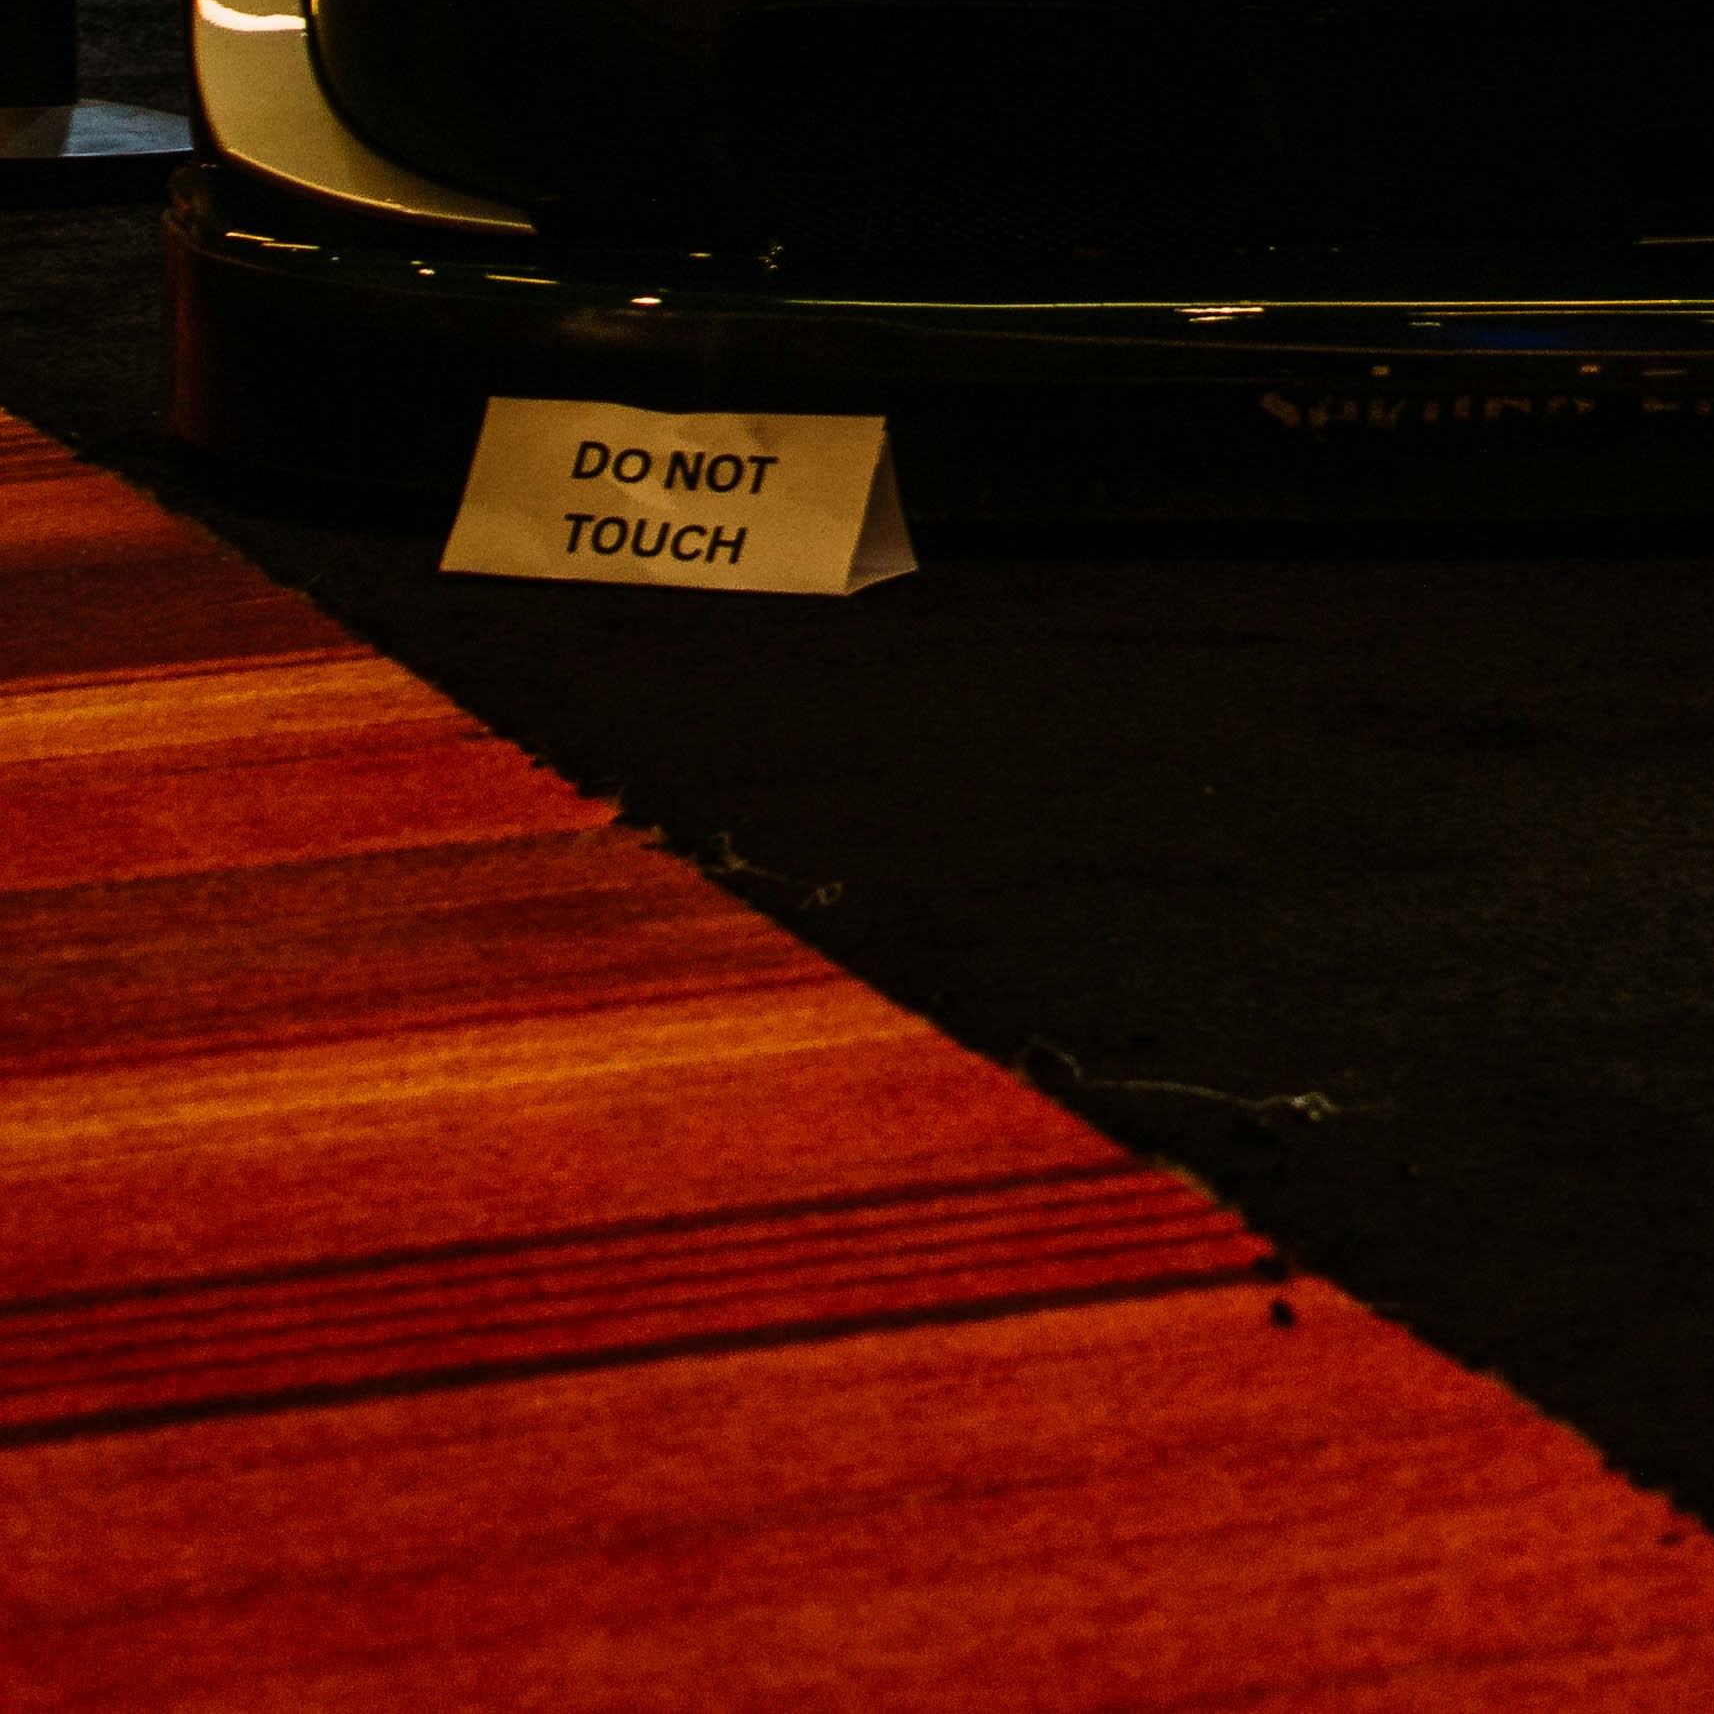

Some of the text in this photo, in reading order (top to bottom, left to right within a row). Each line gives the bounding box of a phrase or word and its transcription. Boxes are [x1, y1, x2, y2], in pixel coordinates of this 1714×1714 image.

[571, 440, 778, 495] DO NOT
[563, 512, 748, 565] TOUCH
